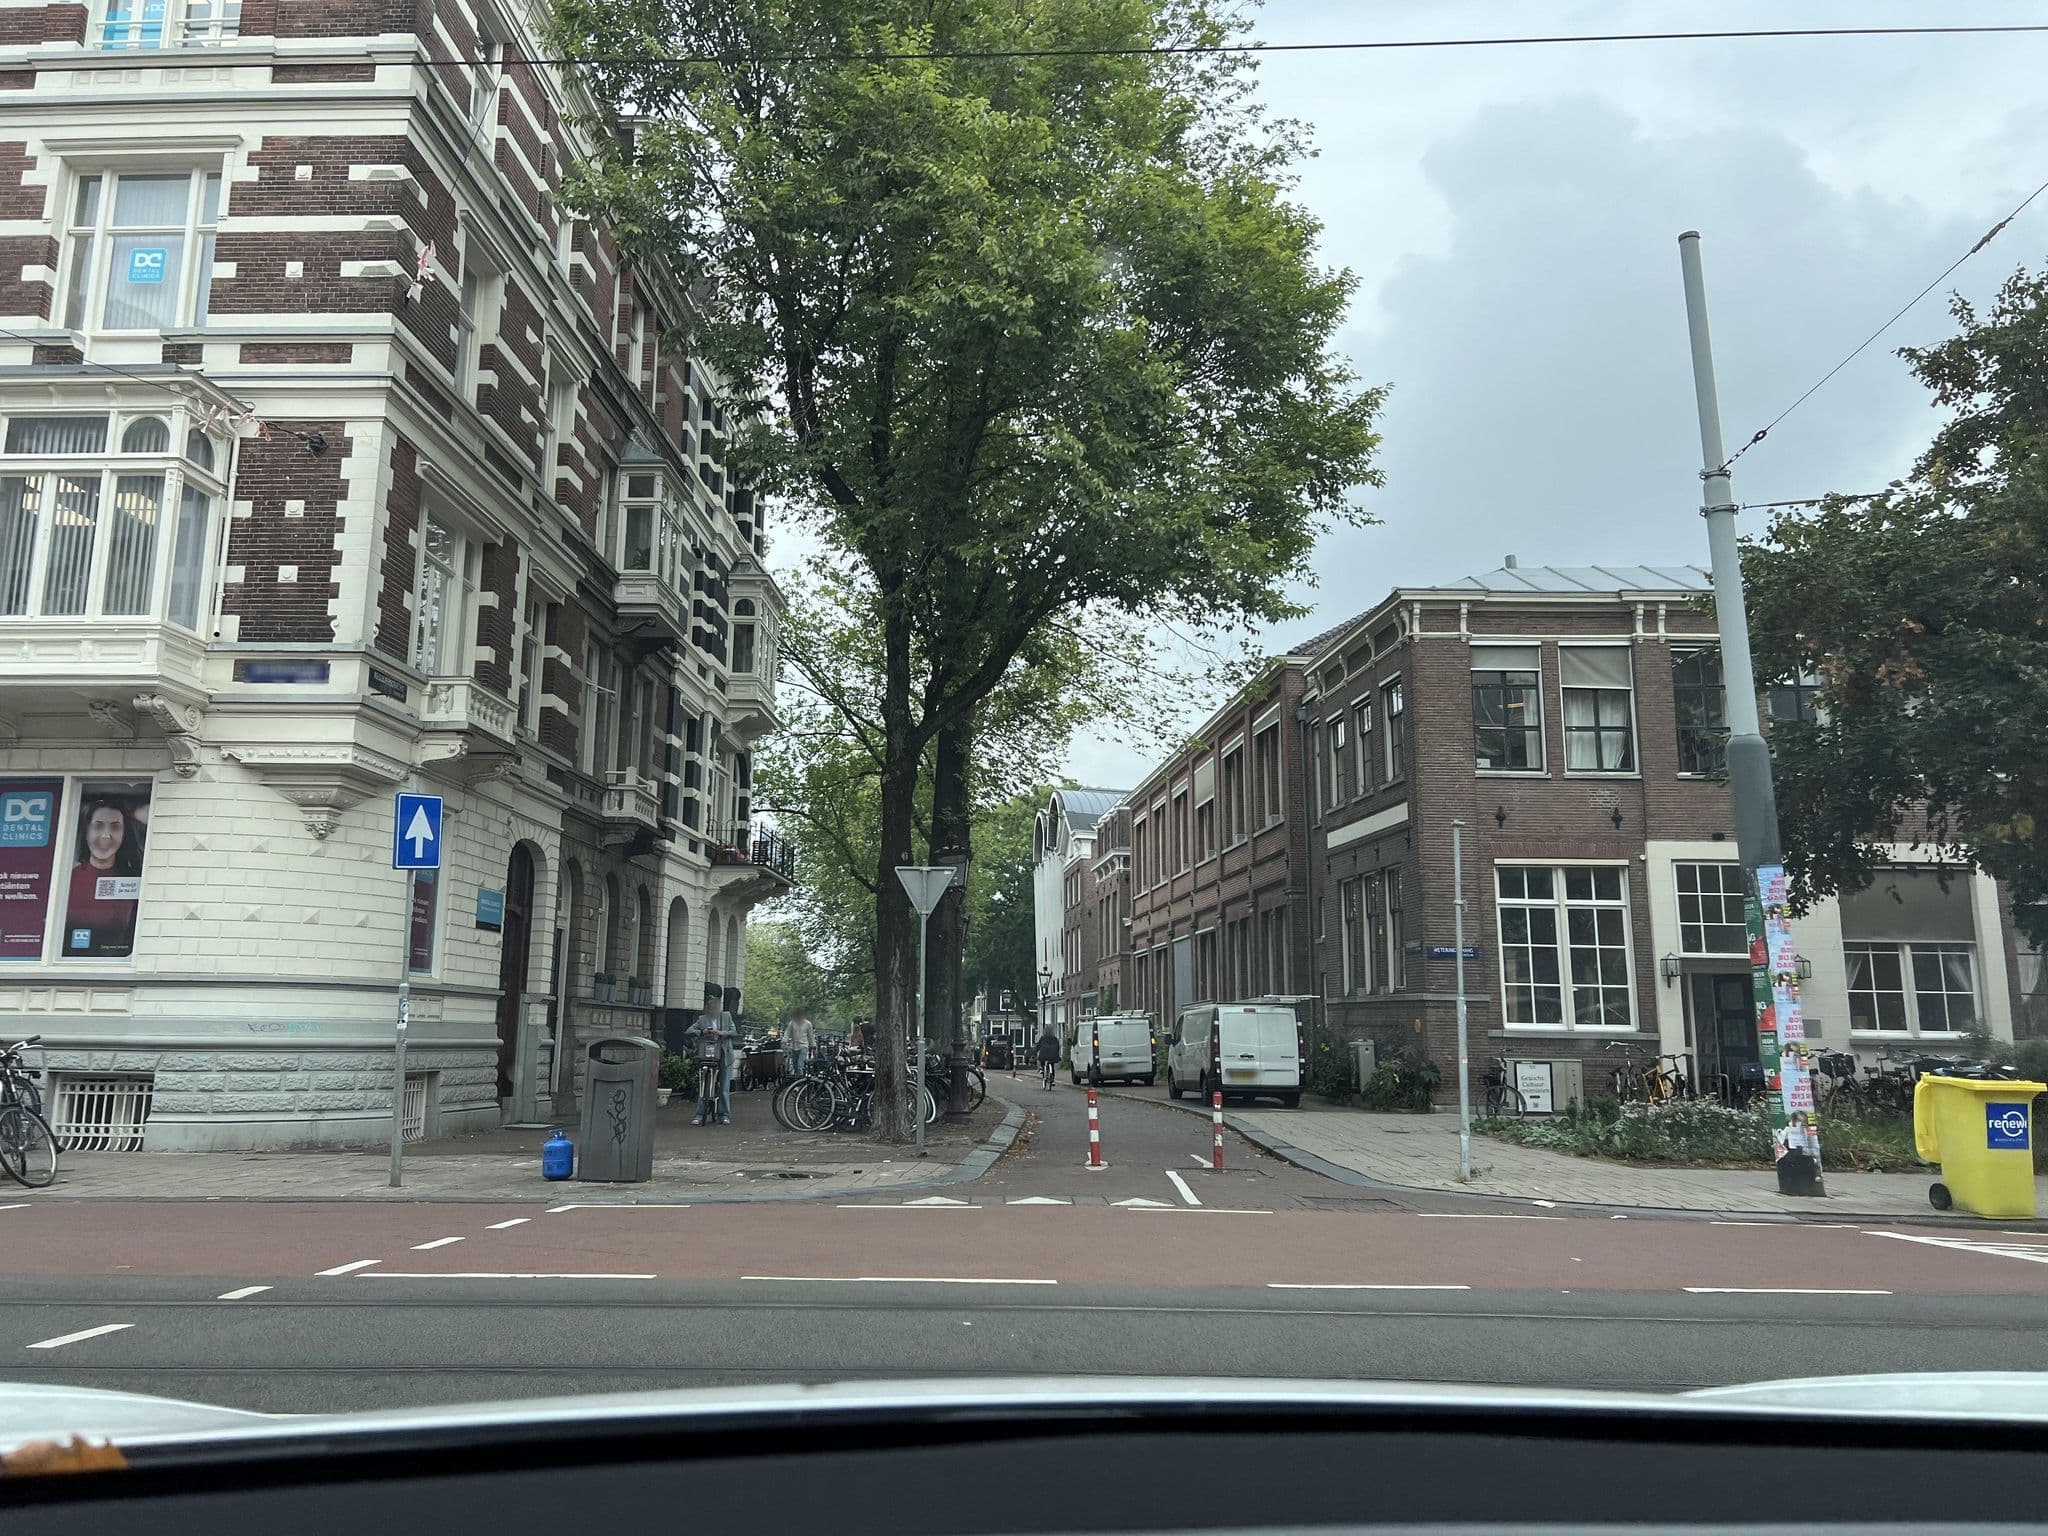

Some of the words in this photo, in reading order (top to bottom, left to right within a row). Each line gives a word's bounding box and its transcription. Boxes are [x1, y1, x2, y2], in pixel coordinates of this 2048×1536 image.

[134, 253, 162, 267] DC
[4, 798, 47, 822] DC
[3, 823, 44, 832] DENTAL
[2, 832, 43, 840] CLINICS
[1988, 1119, 2028, 1129] renewi
